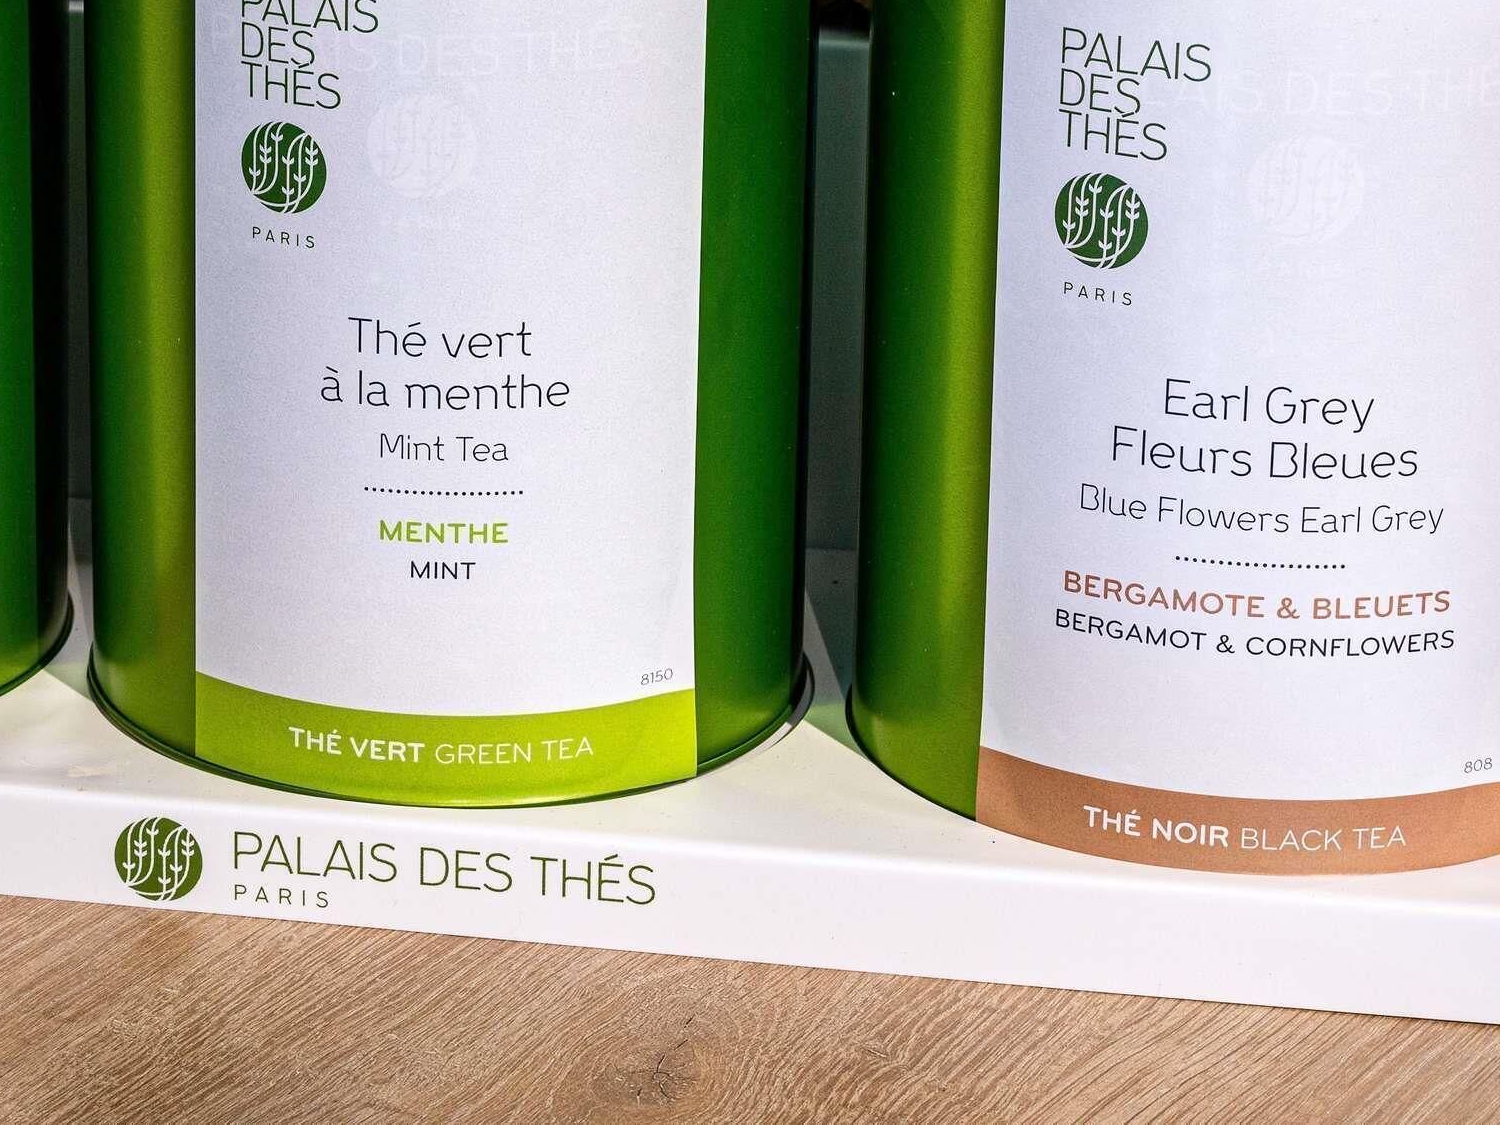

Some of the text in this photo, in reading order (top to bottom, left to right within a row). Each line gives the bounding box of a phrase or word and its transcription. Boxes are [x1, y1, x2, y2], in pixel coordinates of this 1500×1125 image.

[242, 22, 314, 64] DES
[1062, 27, 1211, 82] PALAIS
[241, 61, 341, 109] THÉS
[1060, 69, 1141, 115] DES
[1059, 109, 1168, 161] THÉS
[253, 227, 314, 248] PARIS
[1064, 282, 1131, 305] PARIS
[348, 317, 531, 358] Thé vert
[321, 366, 569, 410] à la menthe
[1165, 379, 1374, 433] Earl Grey
[381, 434, 508, 461] Mint Tea
[1113, 425, 1417, 479] Fleurs Bleues
[1081, 483, 1443, 534] Blue Flowers Earl Grey
[380, 520, 508, 544] MENTHE
[411, 561, 475, 579] MINT
[1063, 570, 1450, 619] BERGAMOTE & BLEUETS
[1056, 608, 1454, 656] BERGAMOT & CORNFLOWERS
[641, 668, 673, 685] 8150
[289, 727, 593, 764] THÉ VERT GREEN TEA
[1464, 758, 1492, 773] 808
[1084, 806, 1406, 851] THÉ NOIR BLACK TEA
[234, 831, 655, 905] PALAIS DES THÉS
[235, 884, 328, 908] PARIS
